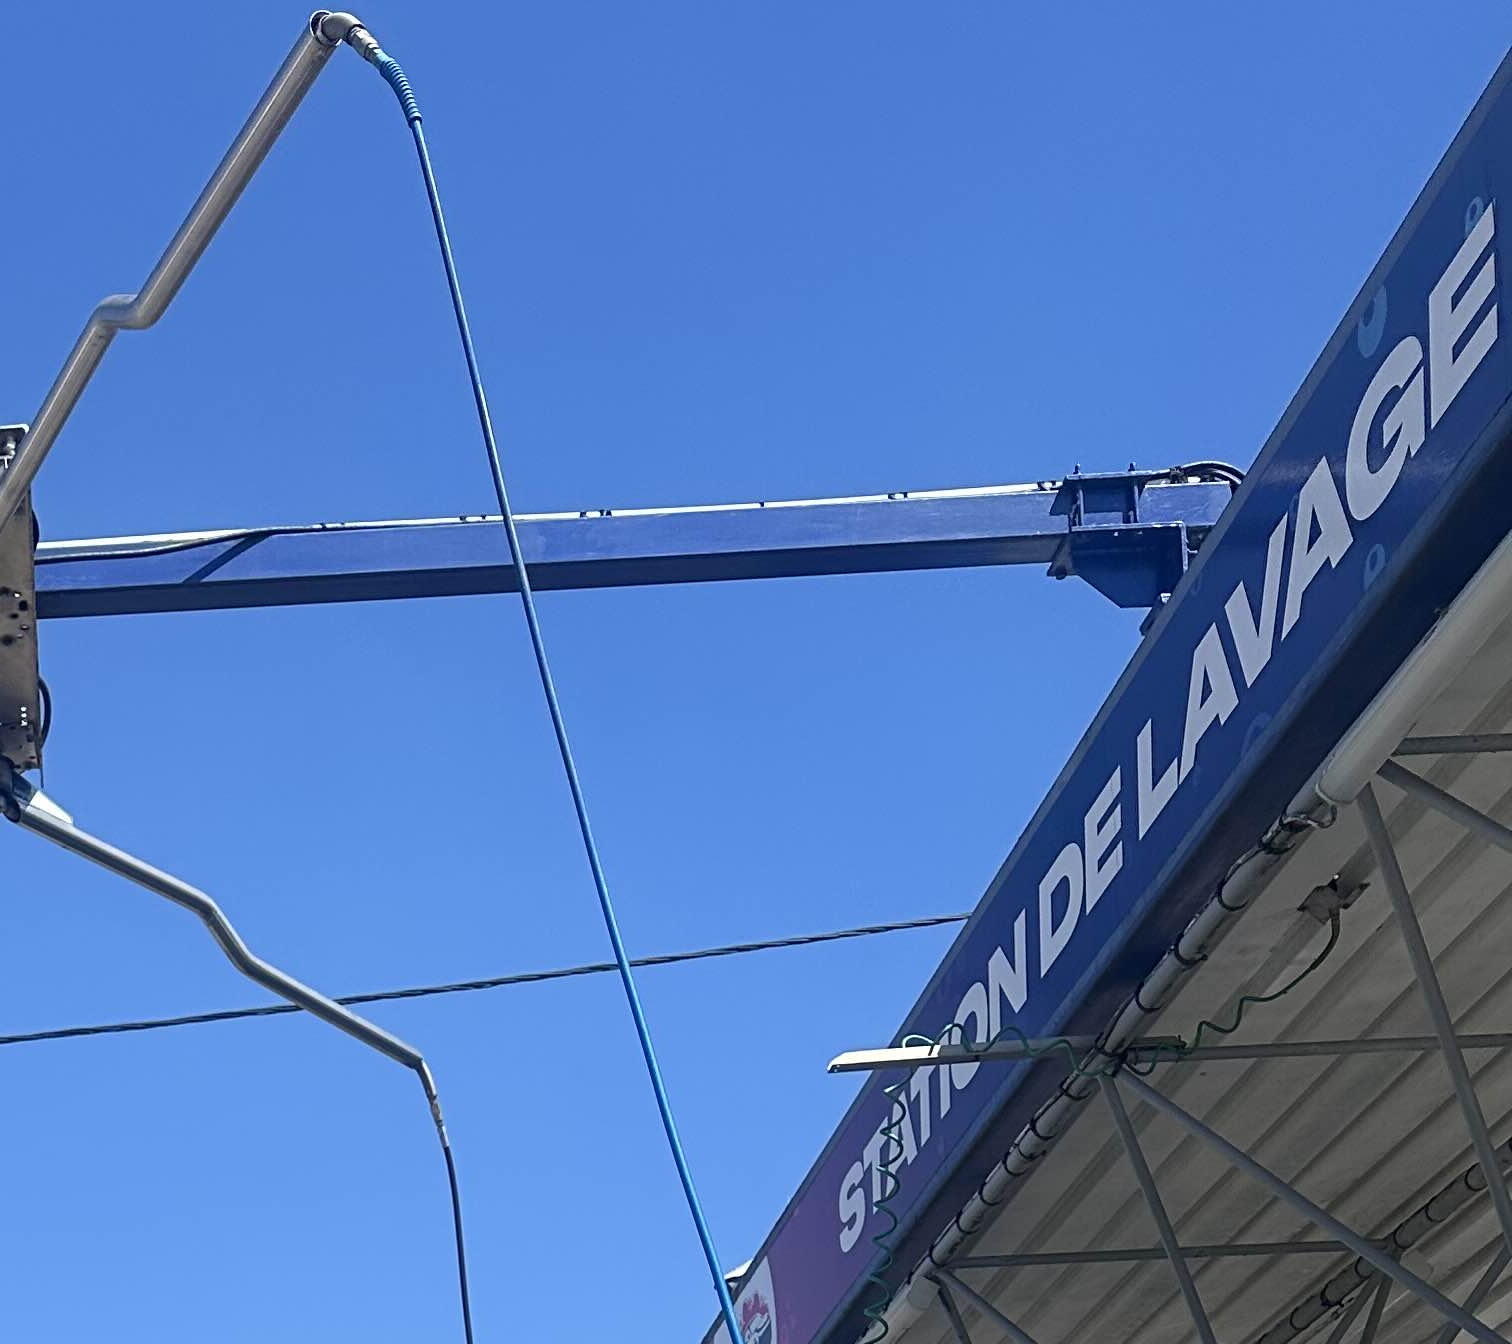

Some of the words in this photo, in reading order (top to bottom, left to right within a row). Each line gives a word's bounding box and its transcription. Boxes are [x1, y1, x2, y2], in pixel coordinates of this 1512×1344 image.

[839, 907, 1028, 1253] STATION
[1038, 764, 1124, 979] DE
[1136, 200, 1499, 841] LAVAGE
